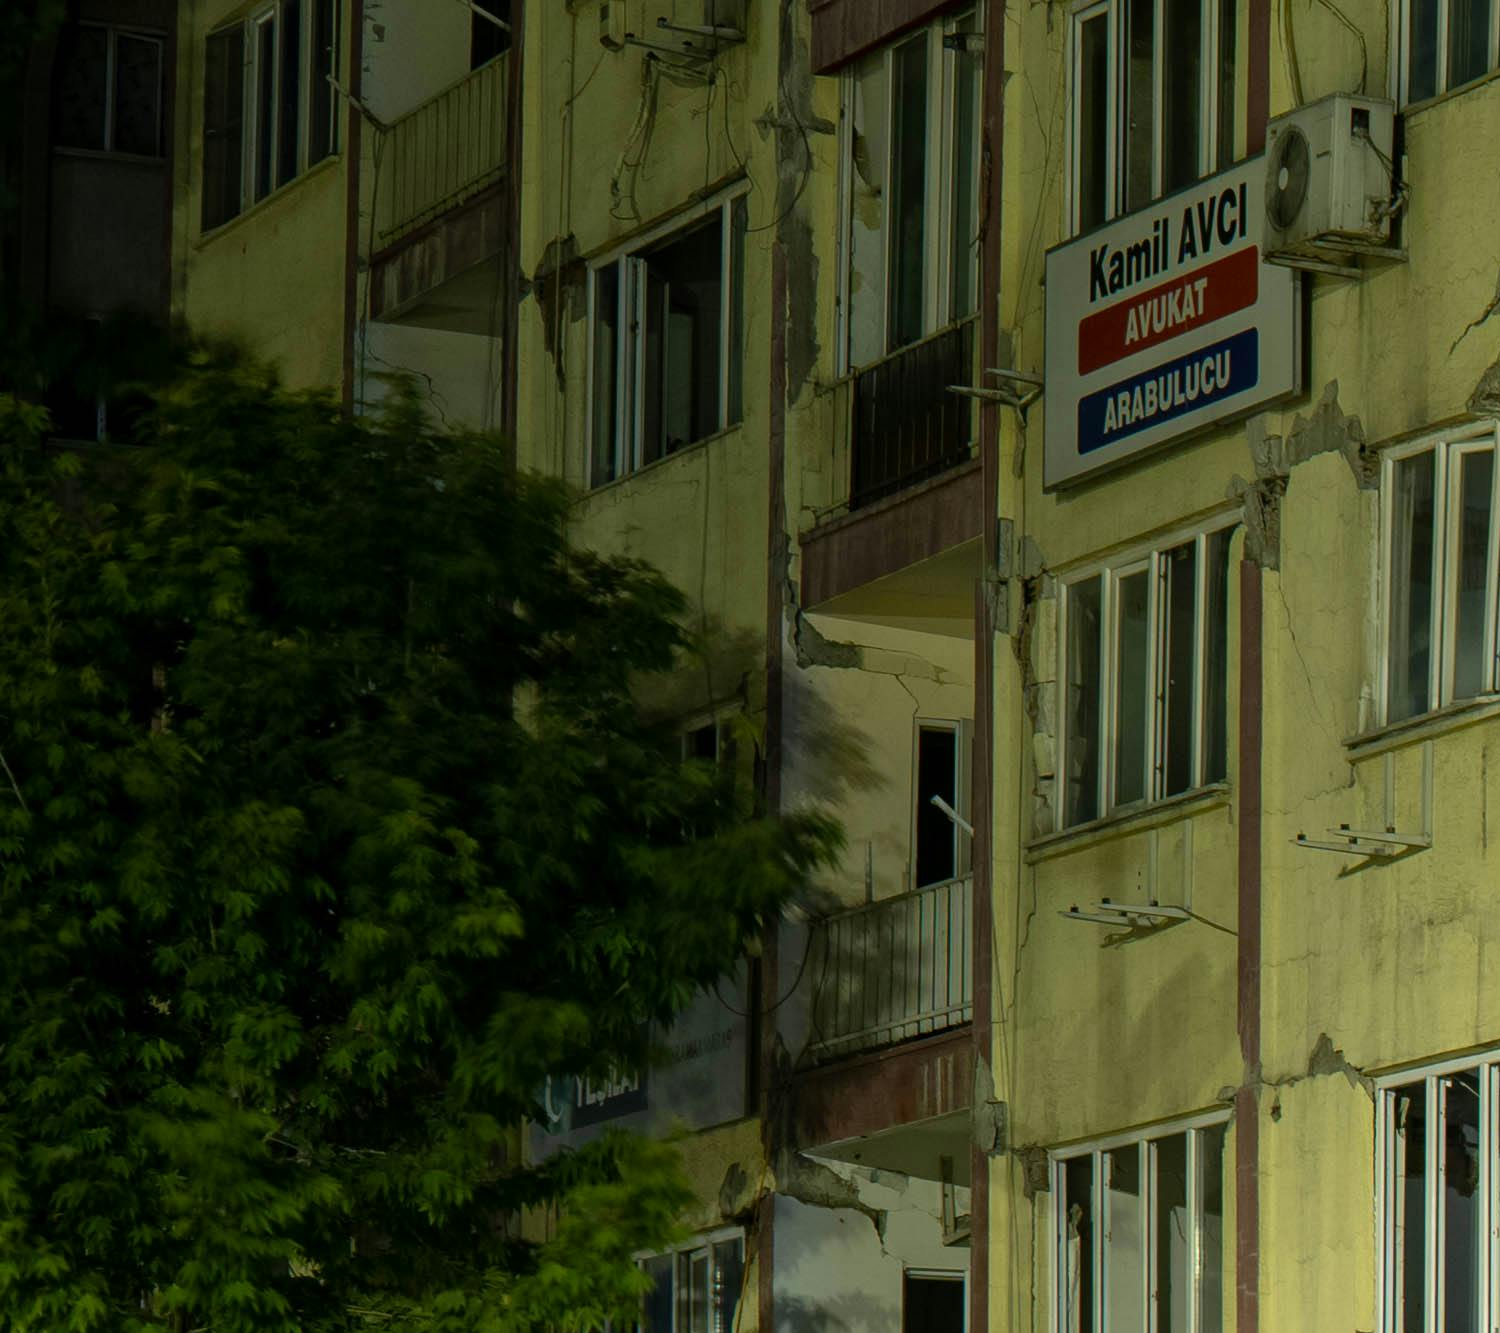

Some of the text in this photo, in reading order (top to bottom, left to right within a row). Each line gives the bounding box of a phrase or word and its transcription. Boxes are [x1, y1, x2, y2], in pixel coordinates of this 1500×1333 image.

[1090, 182, 1246, 303] Kamil AVCI
[1125, 277, 1208, 346] AVUKAT
[1104, 350, 1231, 434] ARABULUCU
